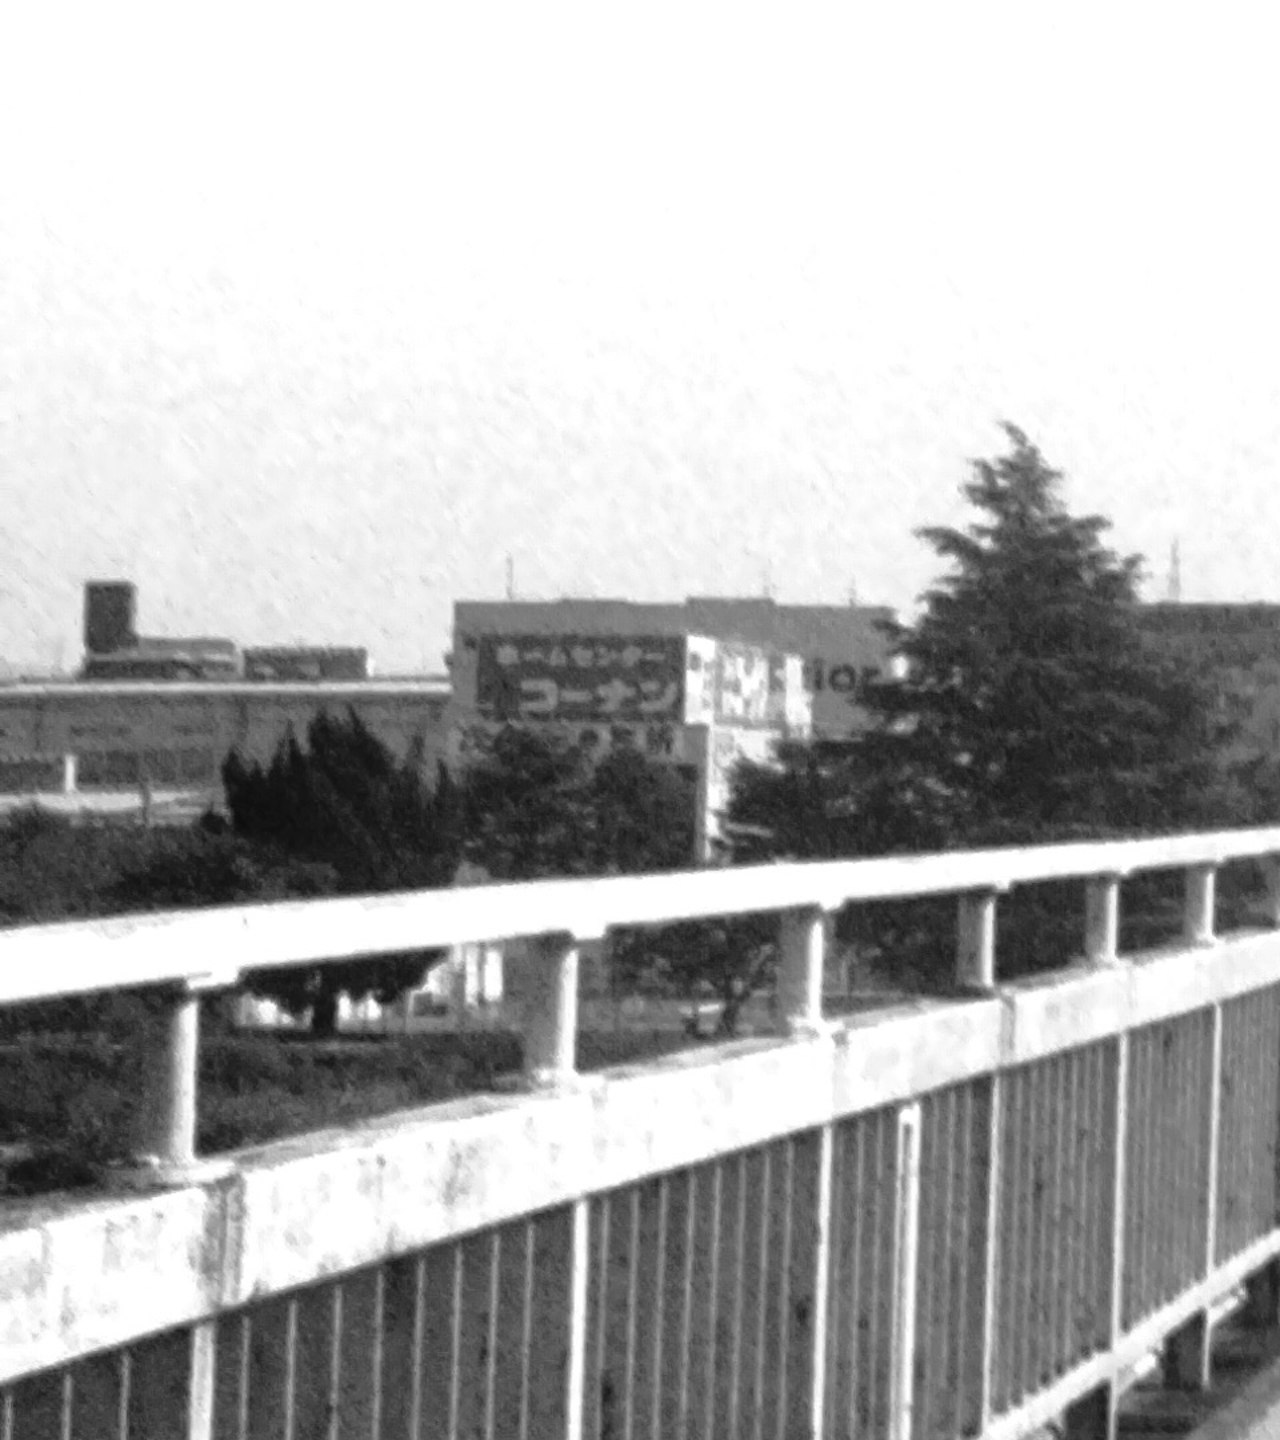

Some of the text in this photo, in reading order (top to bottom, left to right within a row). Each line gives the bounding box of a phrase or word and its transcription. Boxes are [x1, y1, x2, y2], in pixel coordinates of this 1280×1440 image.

[496, 645, 668, 668] ホームセンター
[519, 678, 678, 713] コーナン
